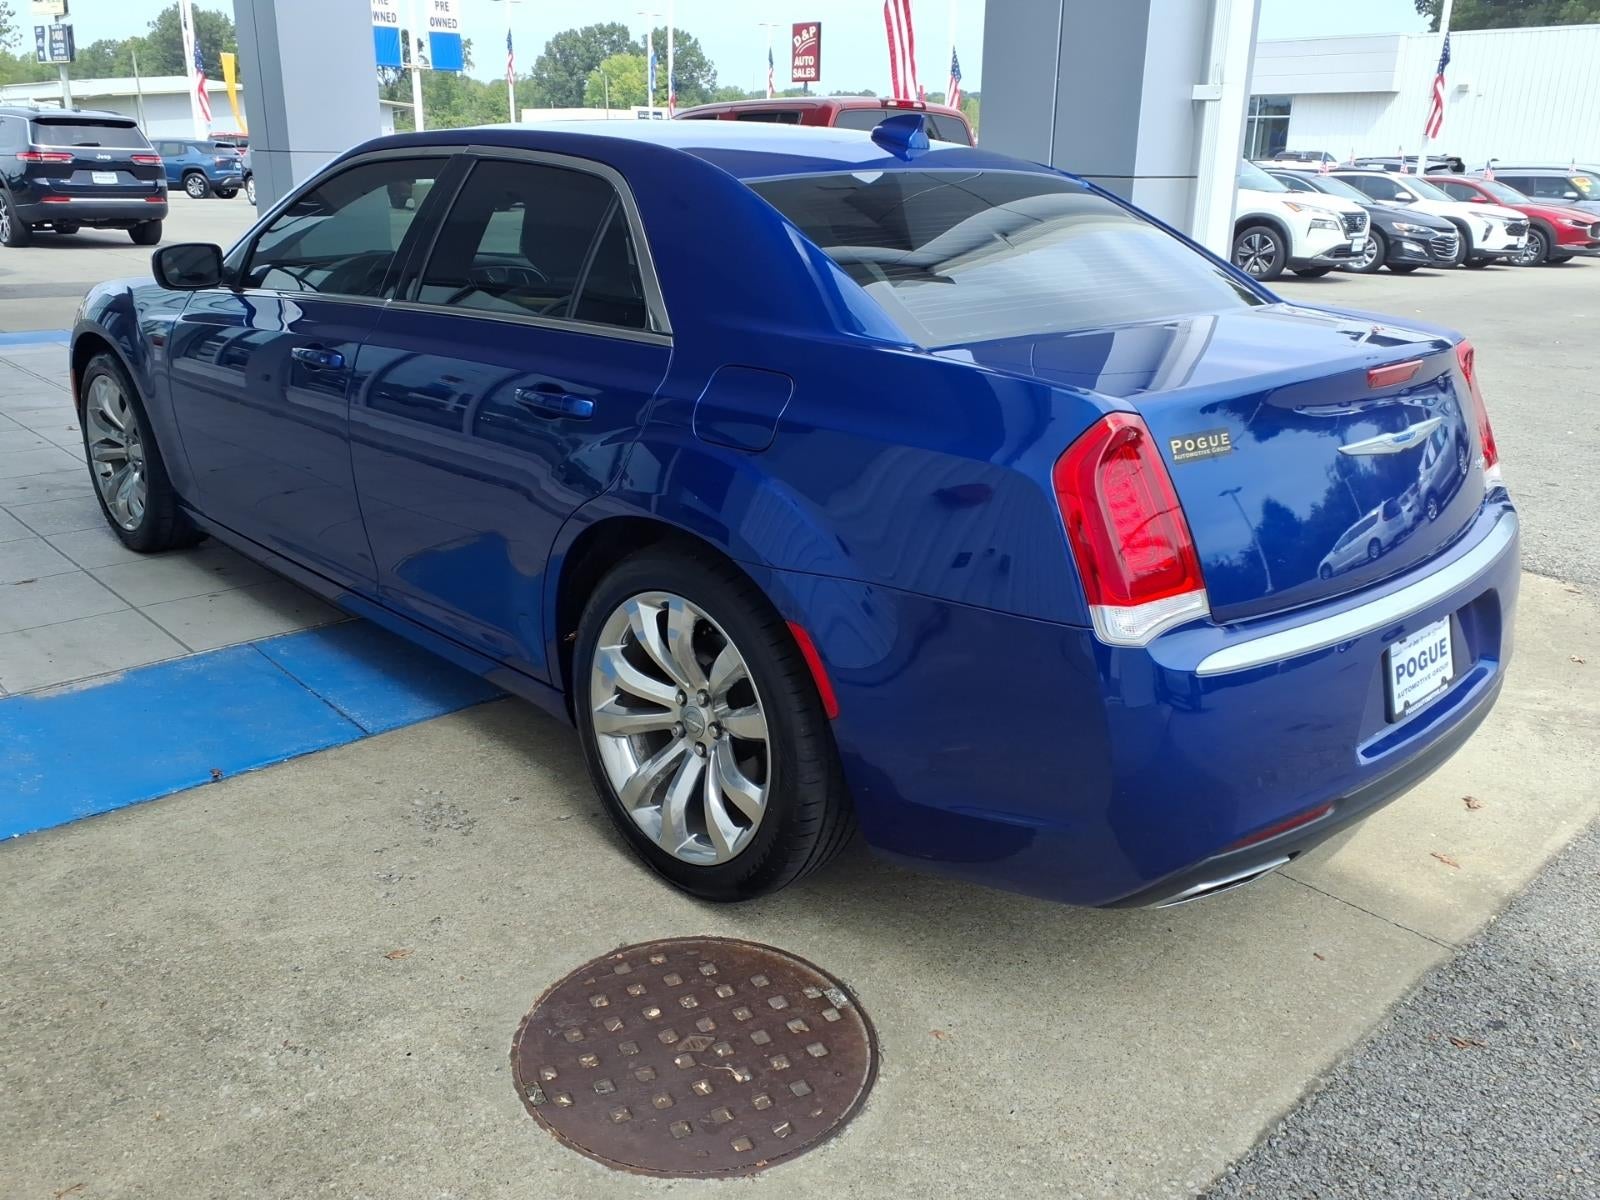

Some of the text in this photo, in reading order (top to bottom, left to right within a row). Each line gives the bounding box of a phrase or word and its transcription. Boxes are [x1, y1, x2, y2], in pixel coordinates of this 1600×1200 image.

[434, 0, 450, 12] PRE
[372, 10, 397, 24] WNED
[429, 17, 458, 29] OWNED
[794, 56, 815, 66] AUTO
[792, 68, 816, 79] SALES
[1170, 432, 1231, 454] POGUE
[1174, 448, 1211, 461] AUTOMOTIVE
[1395, 636, 1448, 686] POGUE
[1432, 661, 1449, 677] GROUP
[1397, 672, 1432, 700] AUTOMOTIVE
